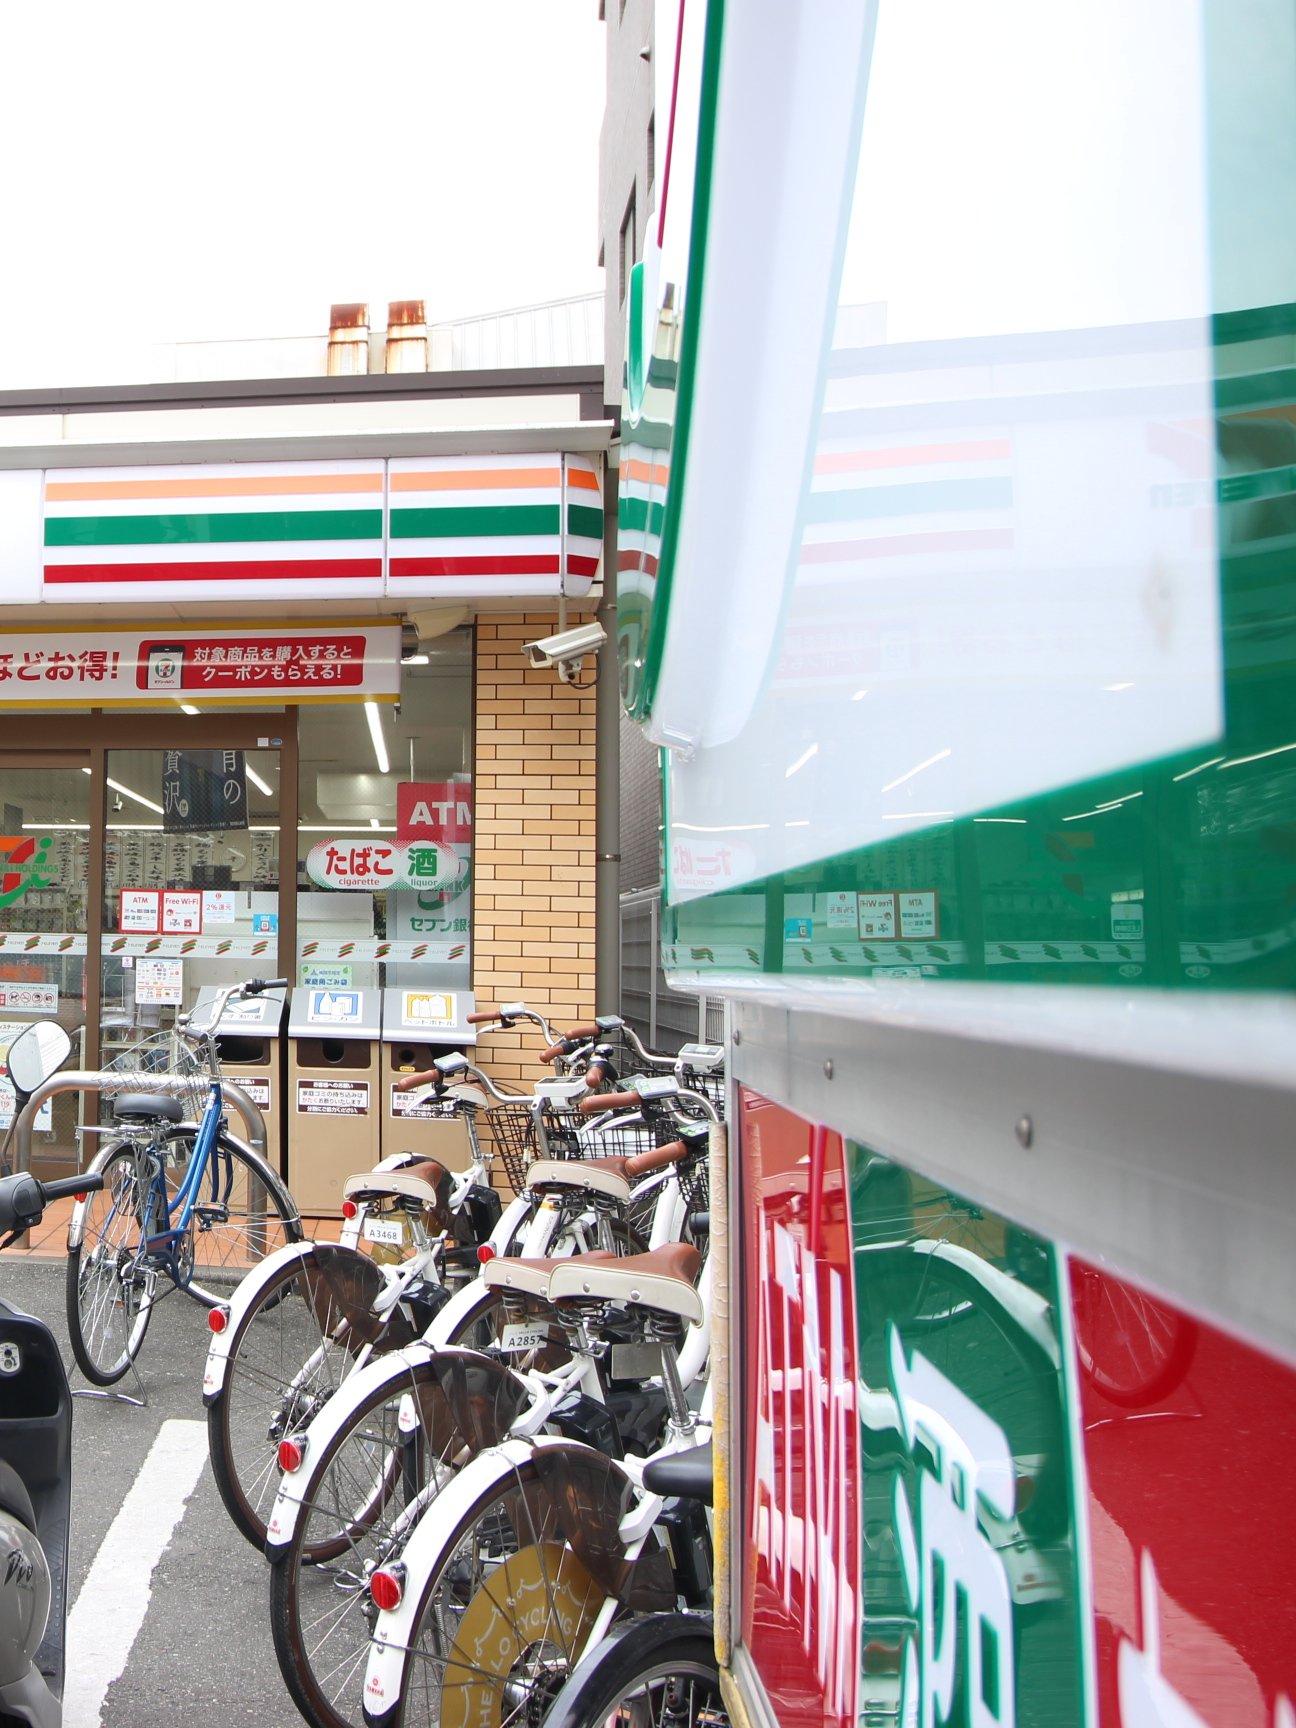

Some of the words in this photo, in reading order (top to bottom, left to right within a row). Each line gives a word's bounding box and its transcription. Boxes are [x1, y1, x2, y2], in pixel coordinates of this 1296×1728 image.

[193, 644, 352, 663] 対象商品を購入すると
[325, 846, 394, 877] たばこ
[407, 847, 438, 877] 酒
[338, 878, 380, 887] cigarette
[410, 878, 438, 887] liquor
[132, 896, 149, 904] ATM
[409, 917, 471, 932] セブン銀
[369, 1229, 398, 1240] A3468
[508, 1335, 542, 1347] A2857
